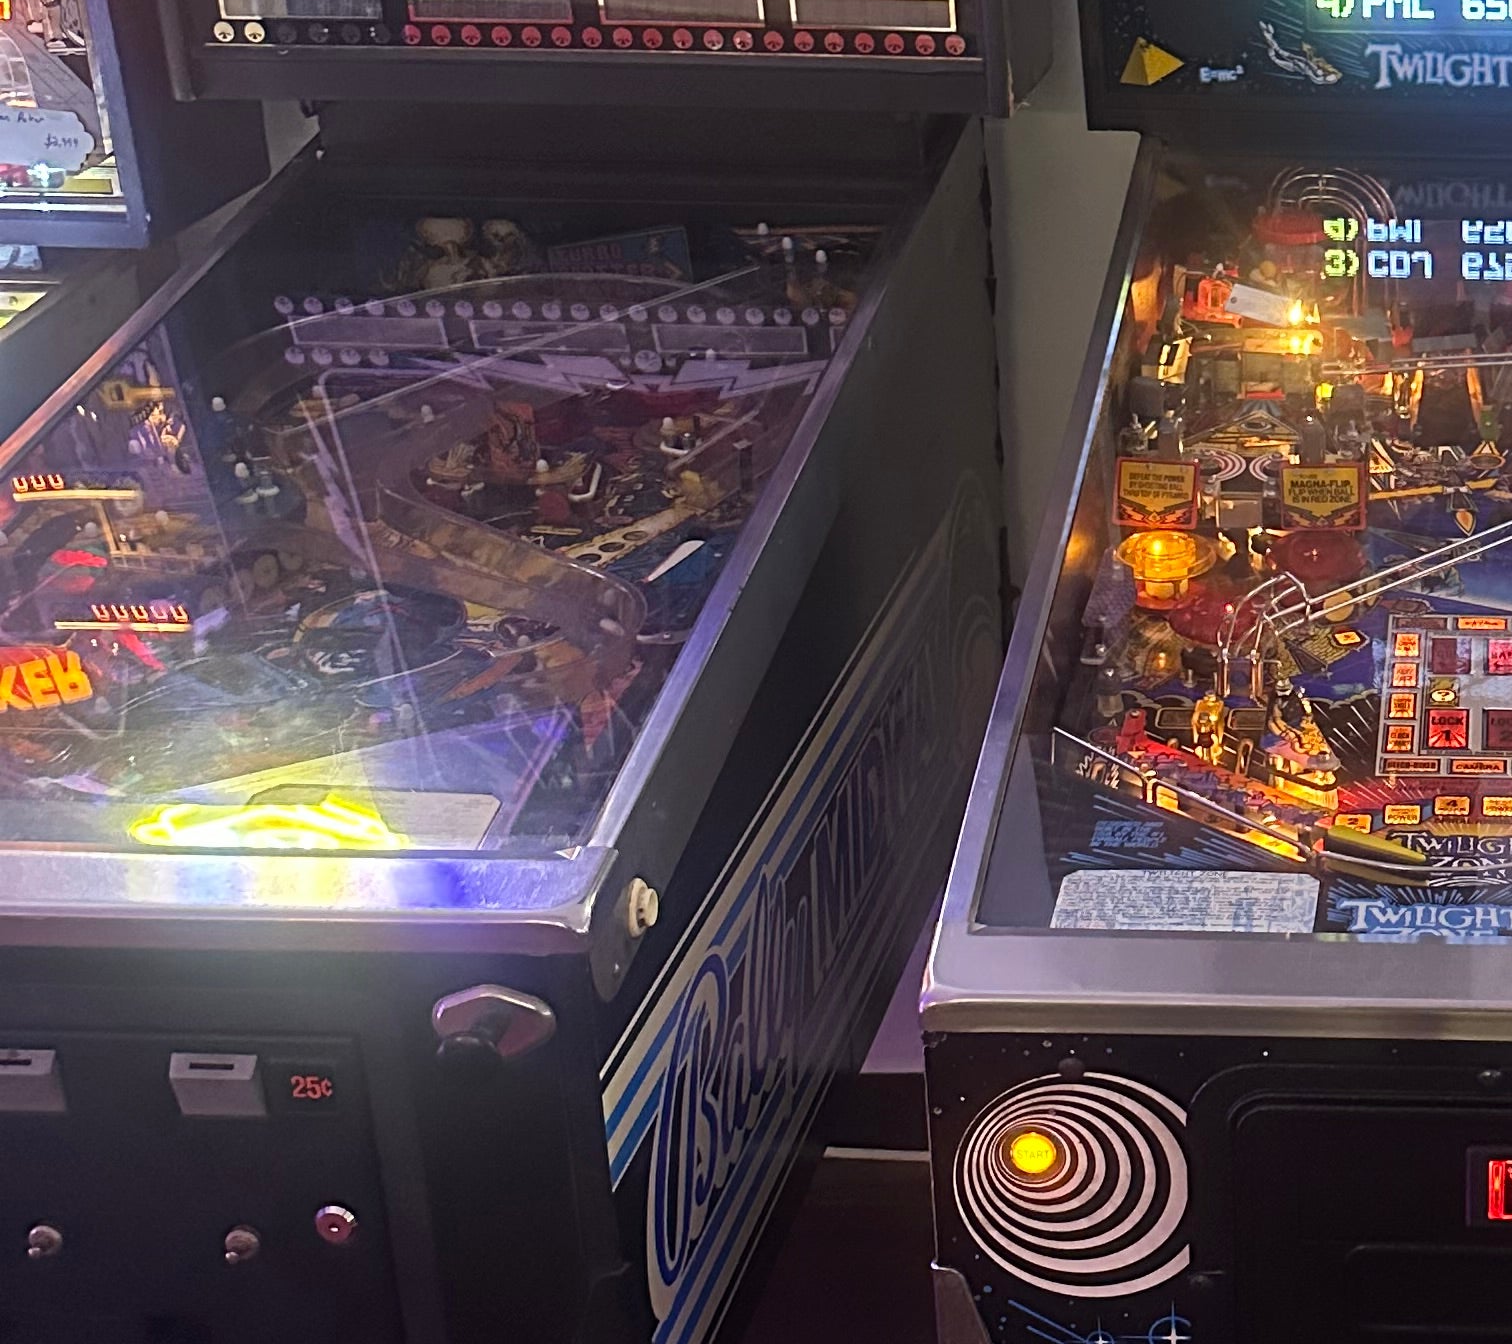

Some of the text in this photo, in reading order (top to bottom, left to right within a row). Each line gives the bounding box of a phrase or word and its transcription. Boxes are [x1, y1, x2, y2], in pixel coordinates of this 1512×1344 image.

[1288, 487, 1356, 498] FLIP WHEN BALL
[1431, 716, 1464, 726] LOCK
[1442, 729, 1452, 742] 1
[290, 1074, 334, 1102] 25¢
[1015, 1147, 1052, 1161] START
